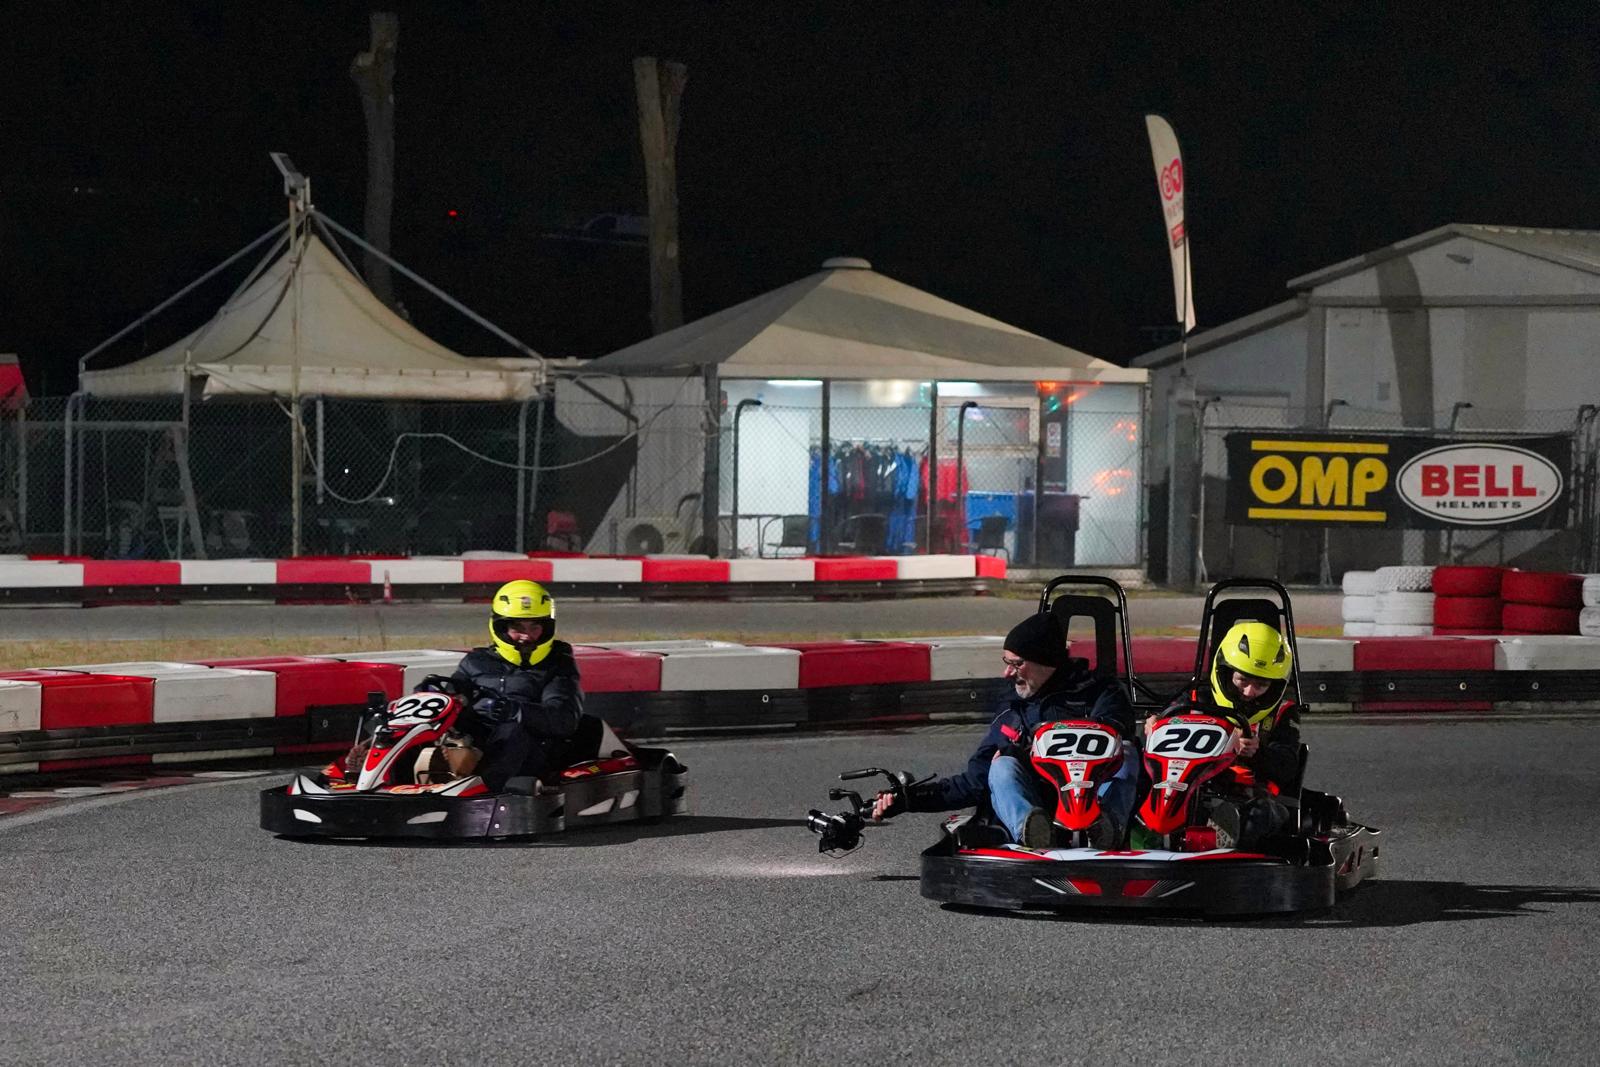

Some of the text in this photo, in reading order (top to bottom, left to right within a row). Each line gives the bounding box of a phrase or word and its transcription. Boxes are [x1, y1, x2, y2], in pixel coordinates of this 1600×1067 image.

[1250, 455, 1389, 506] OMP
[1421, 465, 1537, 497] BELL
[1436, 500, 1522, 509] HELMETS
[393, 698, 445, 718] 28
[1046, 733, 1109, 756] 20
[1153, 728, 1222, 754] 20
